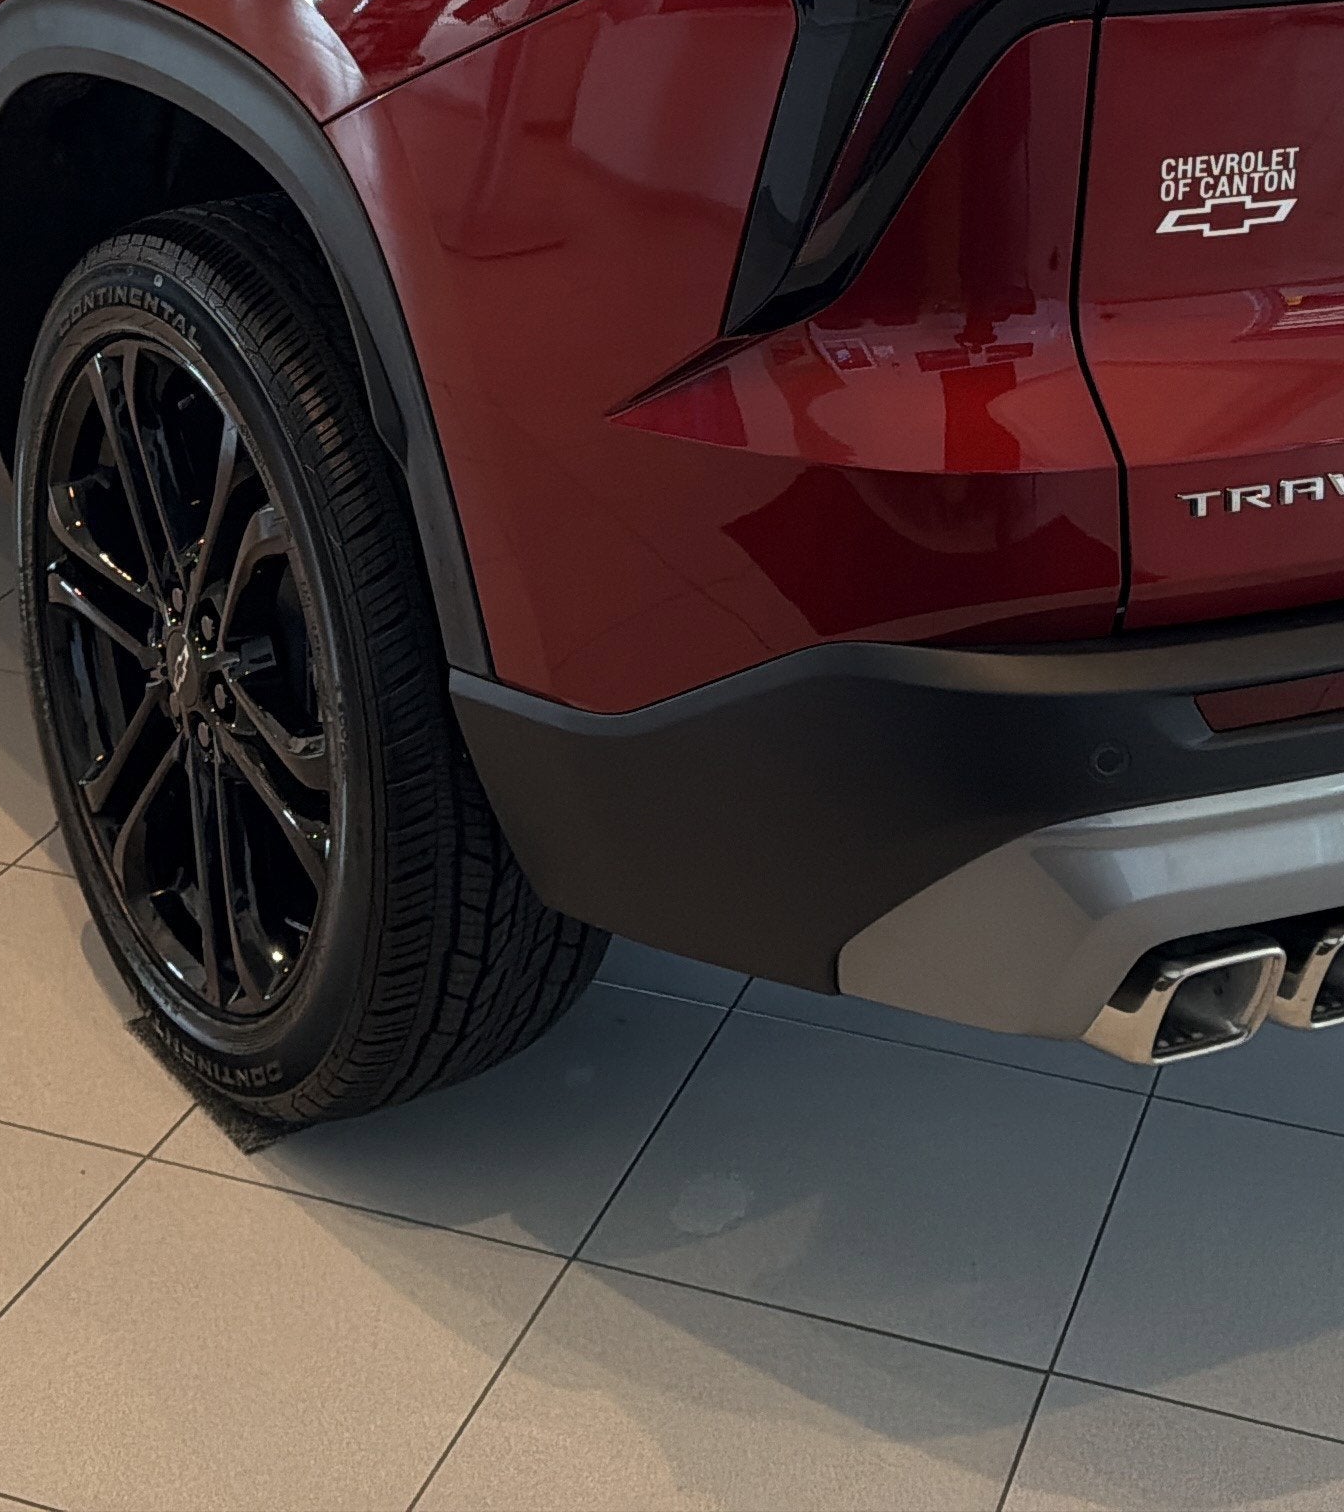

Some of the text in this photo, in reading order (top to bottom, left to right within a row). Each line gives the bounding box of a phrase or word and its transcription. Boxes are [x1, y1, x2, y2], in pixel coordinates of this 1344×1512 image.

[1161, 146, 1300, 180] CHEVROLET
[1160, 169, 1296, 202] OF CANTON
